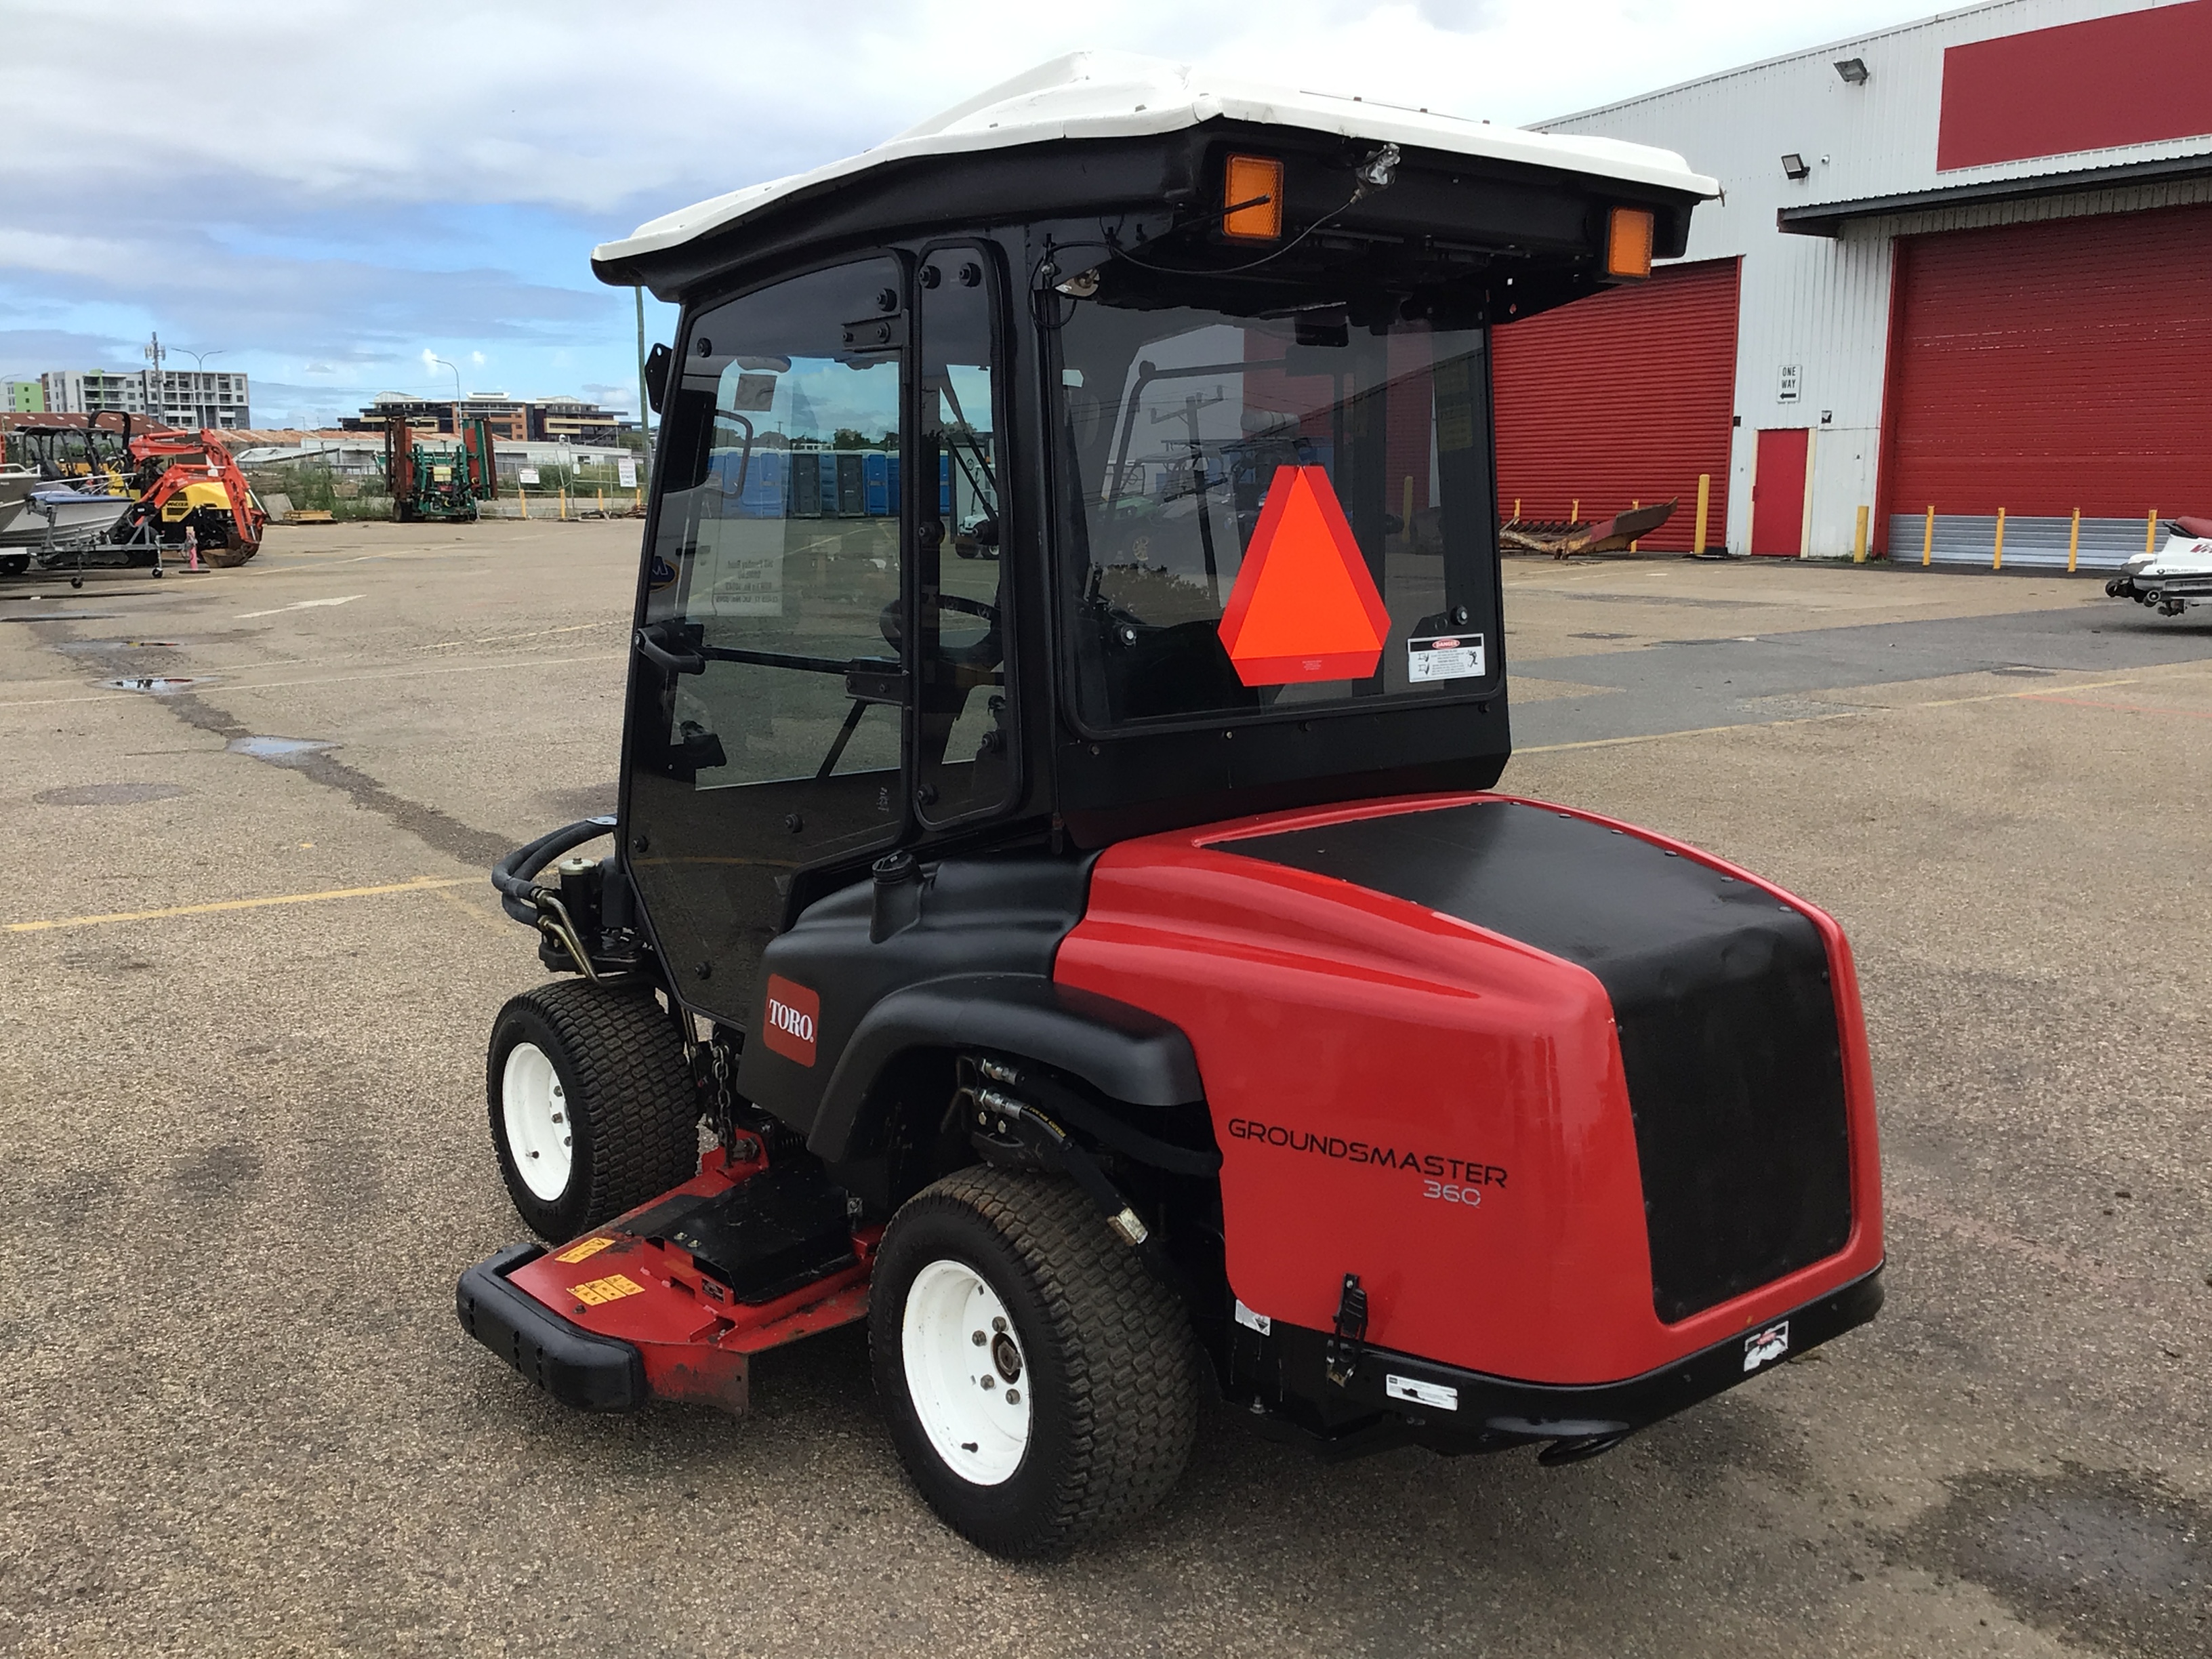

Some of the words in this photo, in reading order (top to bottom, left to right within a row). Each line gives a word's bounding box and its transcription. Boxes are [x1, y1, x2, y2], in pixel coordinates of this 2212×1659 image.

[1781, 380, 1797, 388] WAY
[1782, 367, 1797, 376] ONE
[769, 998, 813, 1041] TORO
[1228, 1118, 1509, 1189] GROUNDSMASTER
[1422, 1179, 1481, 1208] 360
